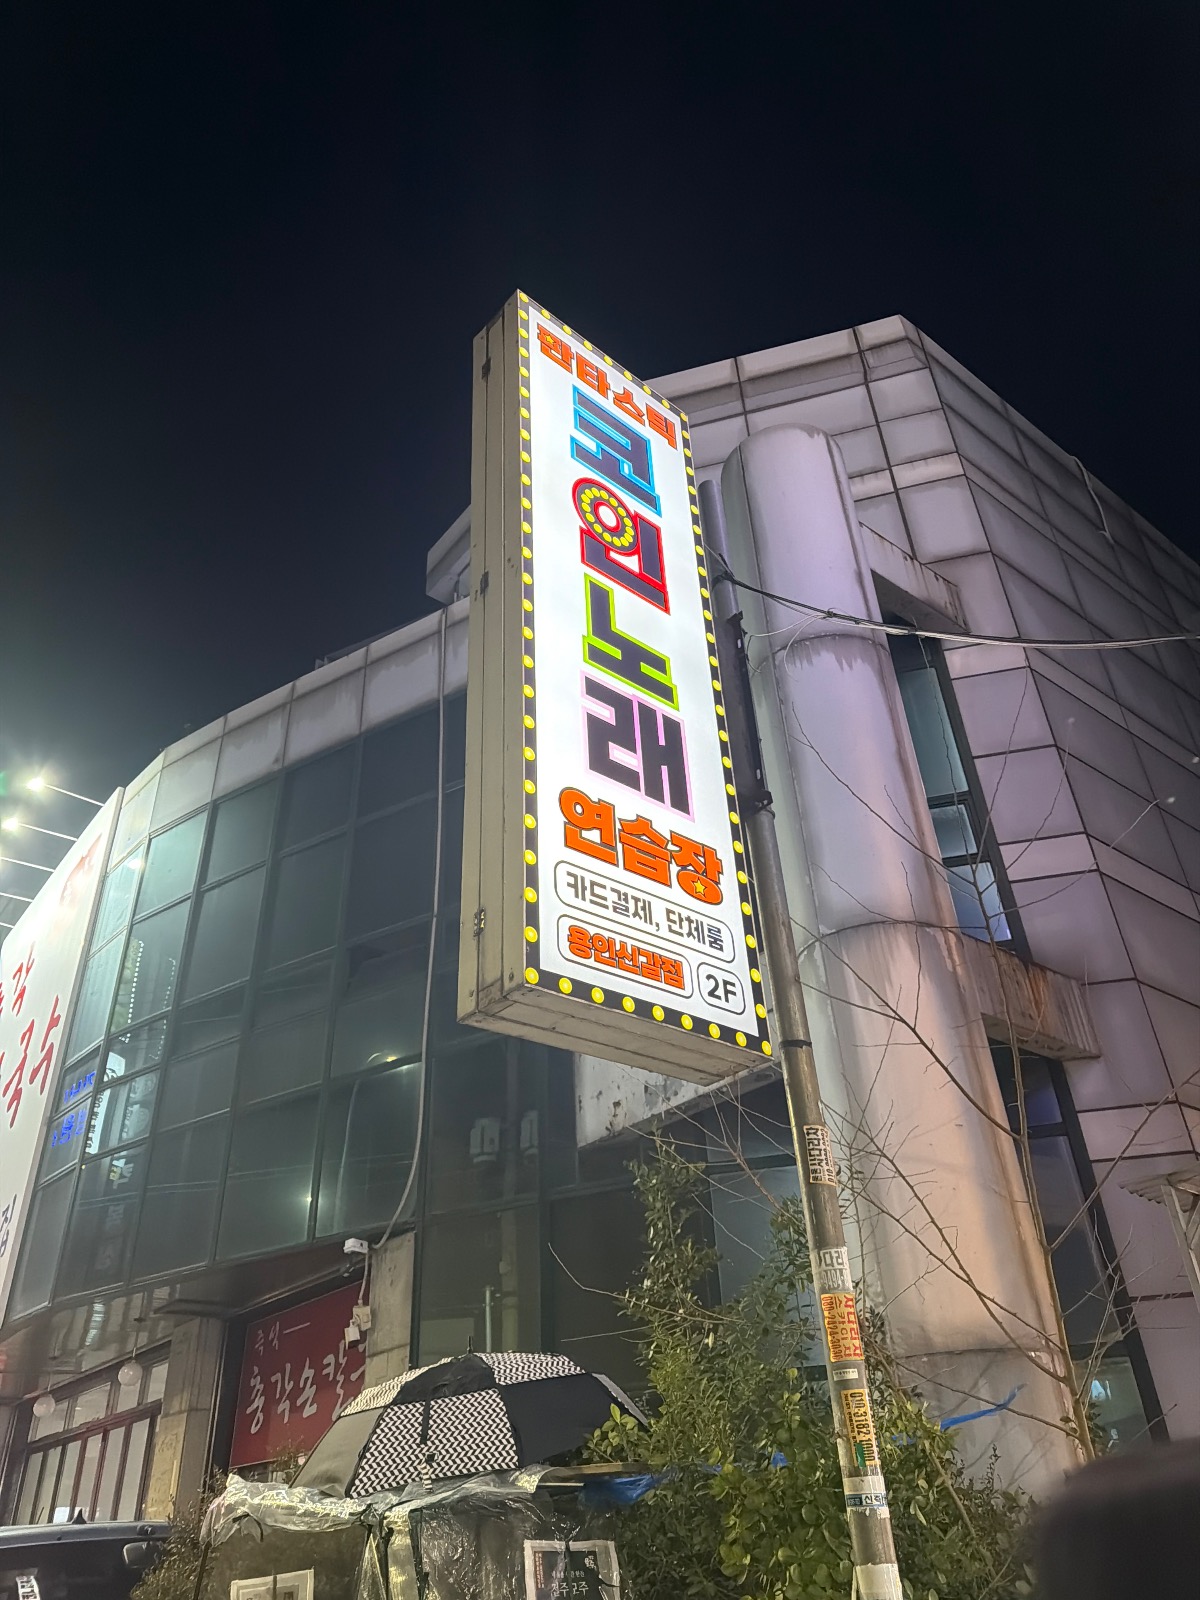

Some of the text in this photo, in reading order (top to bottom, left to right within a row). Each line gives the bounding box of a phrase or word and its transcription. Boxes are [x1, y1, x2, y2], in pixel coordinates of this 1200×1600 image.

[536, 323, 678, 450] 판타스틱
[558, 787, 724, 906] 연습장
[566, 870, 724, 952] 카드결제, 단체룸
[567, 924, 686, 990] 용인신갈점
[705, 973, 737, 1003] 2F
